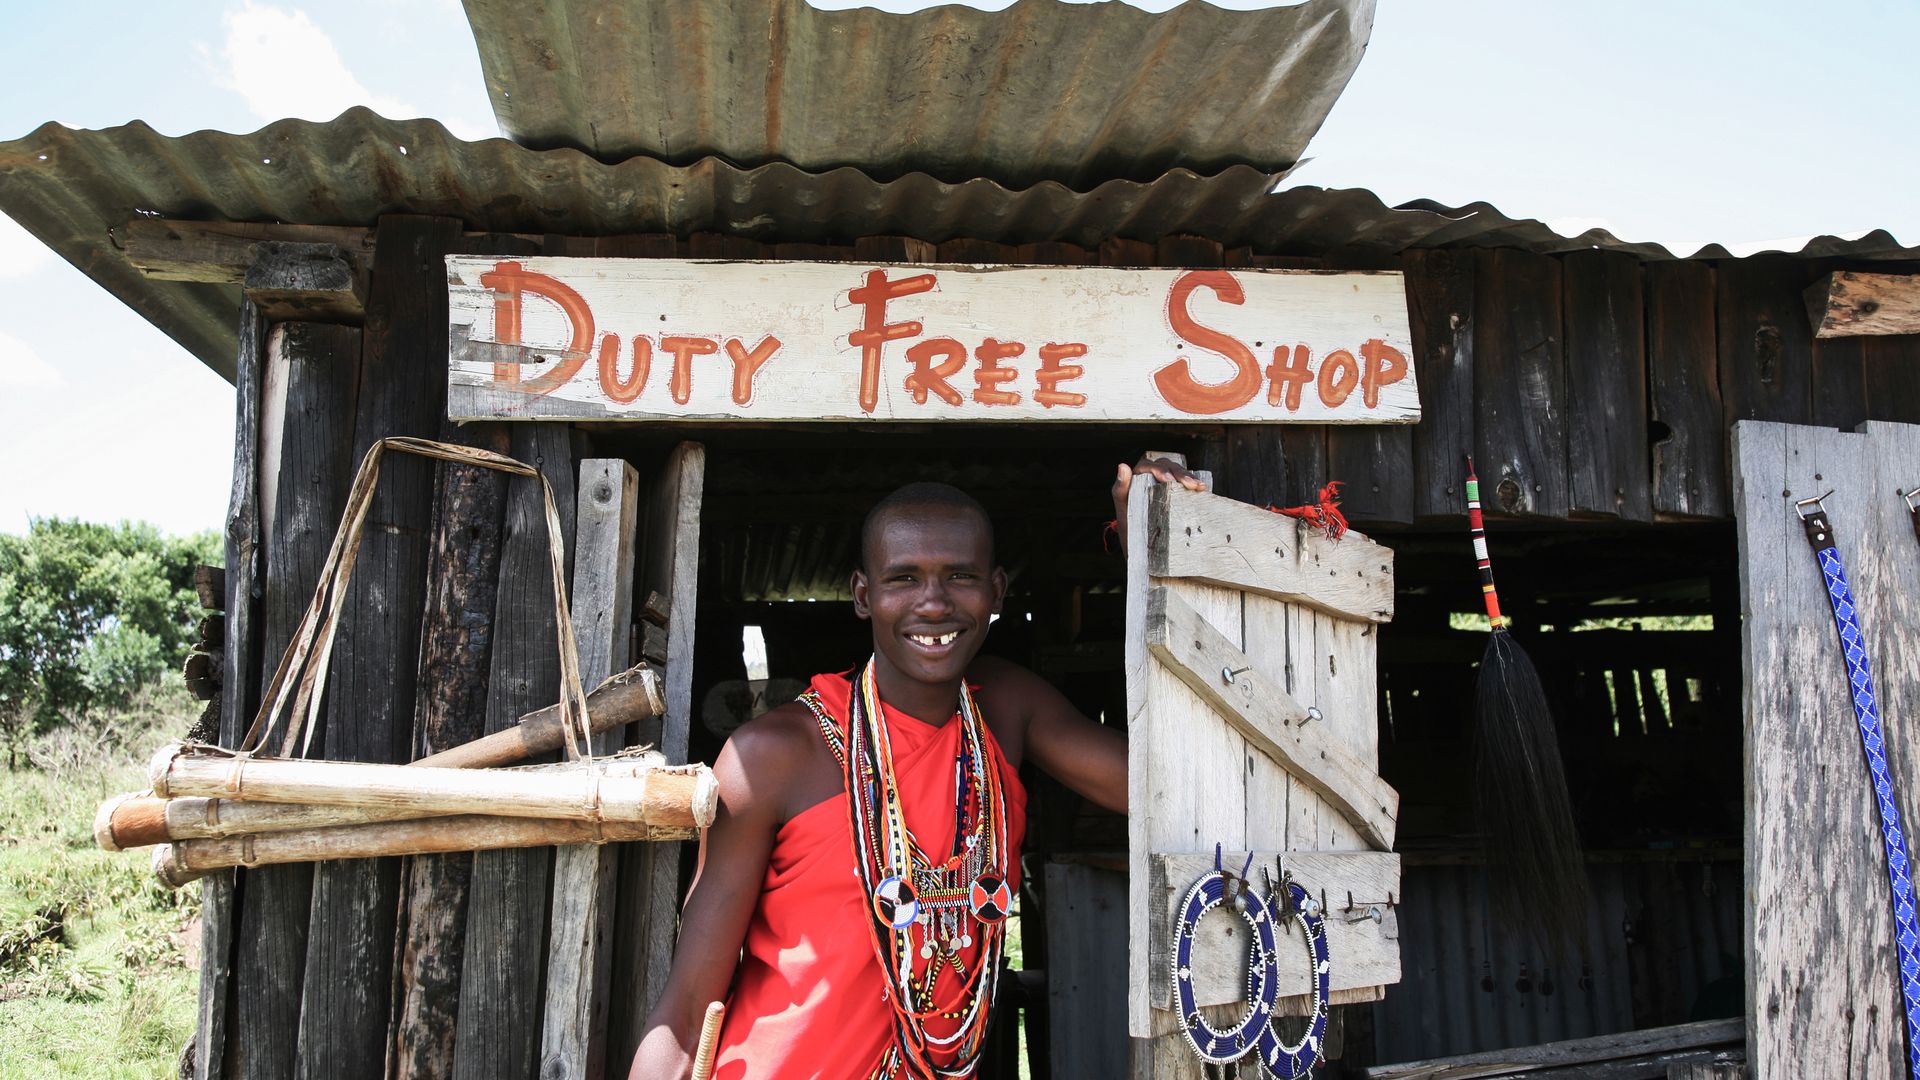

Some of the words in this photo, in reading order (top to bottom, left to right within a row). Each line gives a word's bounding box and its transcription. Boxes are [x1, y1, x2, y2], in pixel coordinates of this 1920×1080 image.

[480, 261, 782, 406] DUTY
[840, 269, 1087, 413] FREE
[1155, 269, 1409, 414] SHOP
